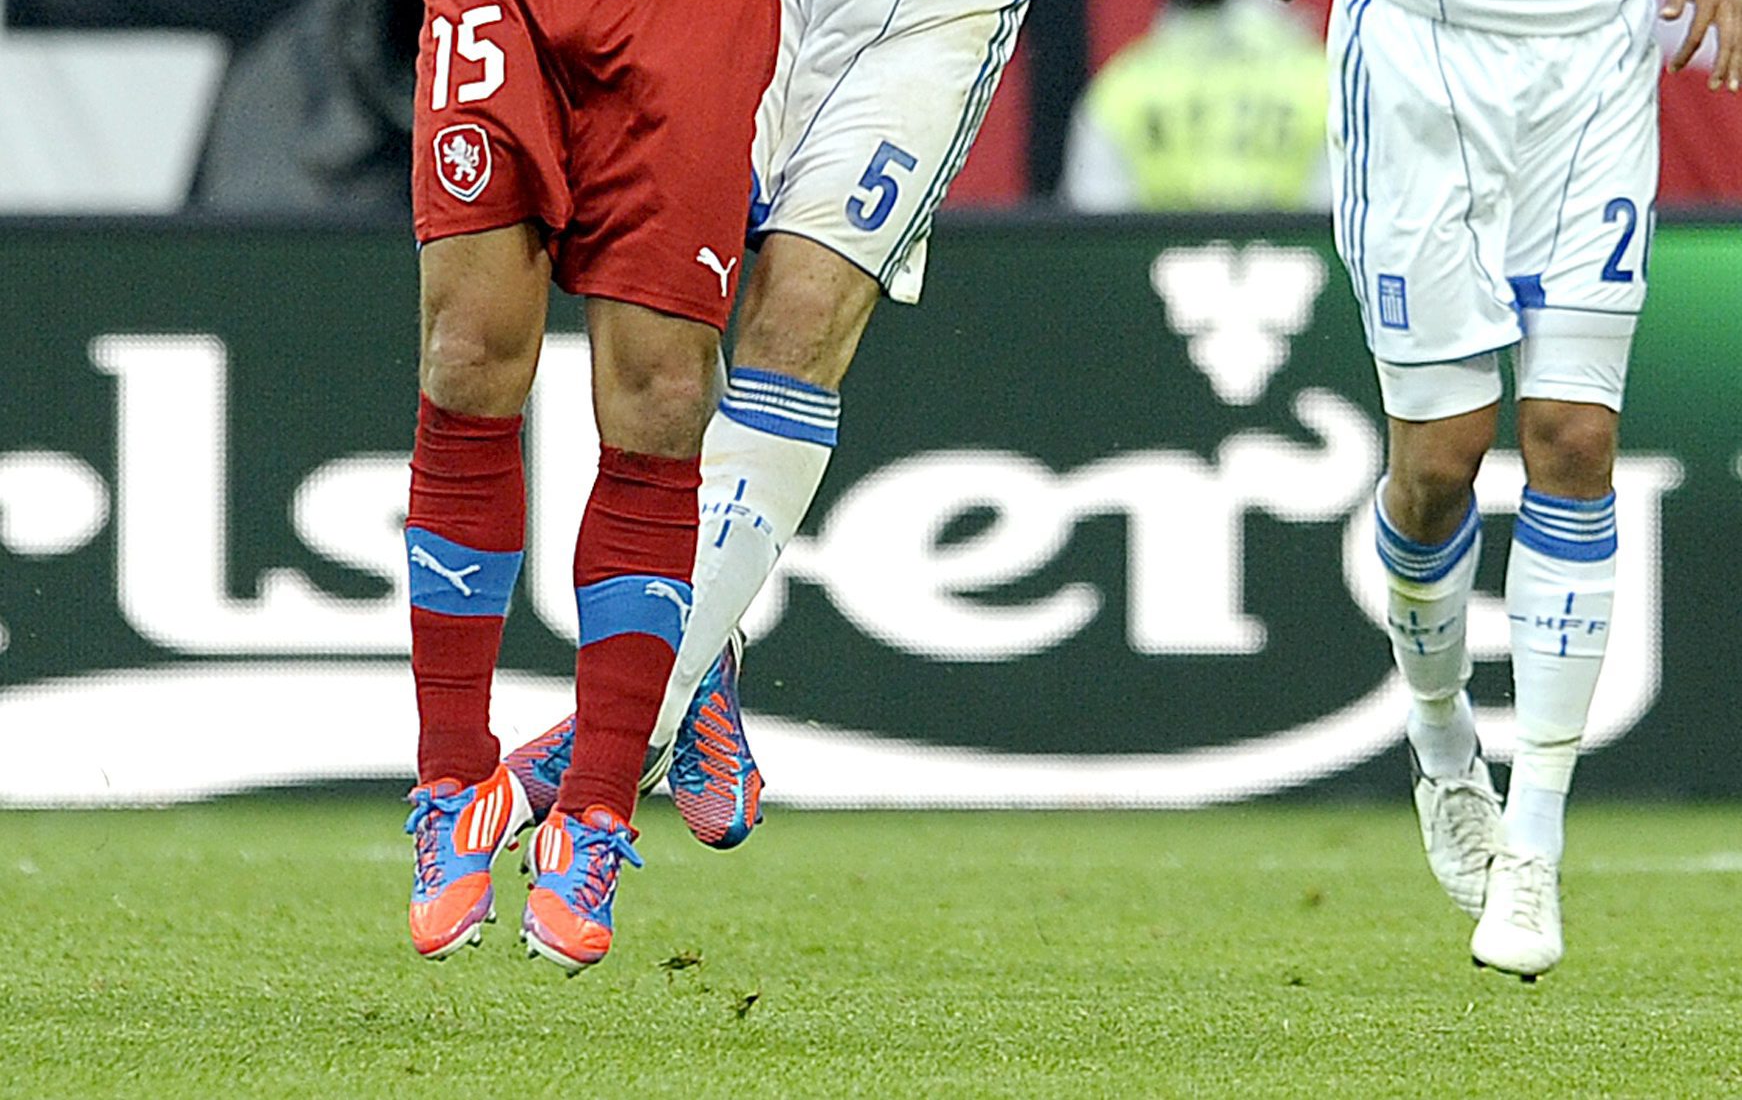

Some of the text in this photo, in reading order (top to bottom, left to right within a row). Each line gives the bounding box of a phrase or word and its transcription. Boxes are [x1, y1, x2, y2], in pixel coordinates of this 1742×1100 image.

[432, 4, 505, 111] 15
[845, 140, 918, 232] 5
[1601, 197, 1637, 282] 2
[1534, 615, 1607, 636] HFF
